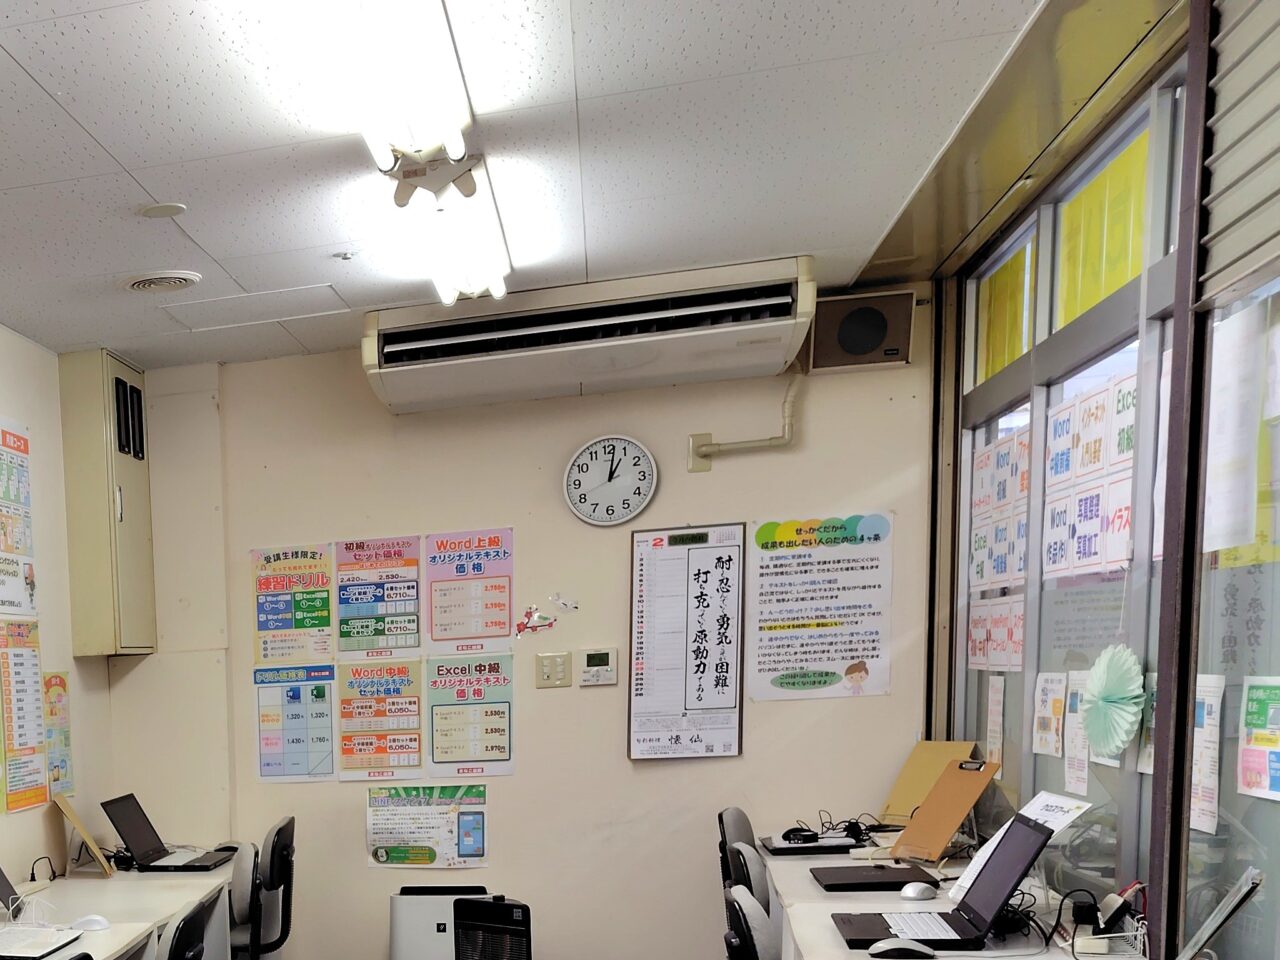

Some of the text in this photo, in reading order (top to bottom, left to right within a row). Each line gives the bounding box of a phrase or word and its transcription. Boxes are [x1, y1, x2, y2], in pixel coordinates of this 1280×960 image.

[1052, 411, 1071, 441] Word
[602, 443, 616, 455] 12
[622, 446, 627, 457] 1
[589, 450, 598, 462] 11
[632, 455, 641, 467] 2
[995, 446, 1011, 471] Word
[576, 462, 589, 474] 10
[638, 470, 647, 482] 3
[573, 478, 582, 490] 9
[632, 486, 642, 497] 4
[578, 493, 587, 504] 8
[621, 498, 630, 510] 5
[590, 502, 600, 514] 7
[605, 504, 615, 516] 6
[1050, 504, 1067, 530] Word
[795, 525, 847, 536] せっかくだから
[994, 523, 1008, 545] Word
[435, 535, 501, 552] Word 上級
[651, 537, 665, 547] 2
[1075, 532, 1099, 562] 写真加工
[263, 550, 323, 565] 受講生様限定!
[352, 549, 405, 562] セット価格
[428, 549, 511, 564] オリジナルテキスト
[455, 562, 485, 575] 価格
[256, 571, 331, 593] 練習ドリル
[351, 666, 410, 679] Word 中級
[437, 662, 501, 676] Excel 中級
[430, 676, 511, 688] オリジナルテキスト
[455, 688, 485, 700] 価格
